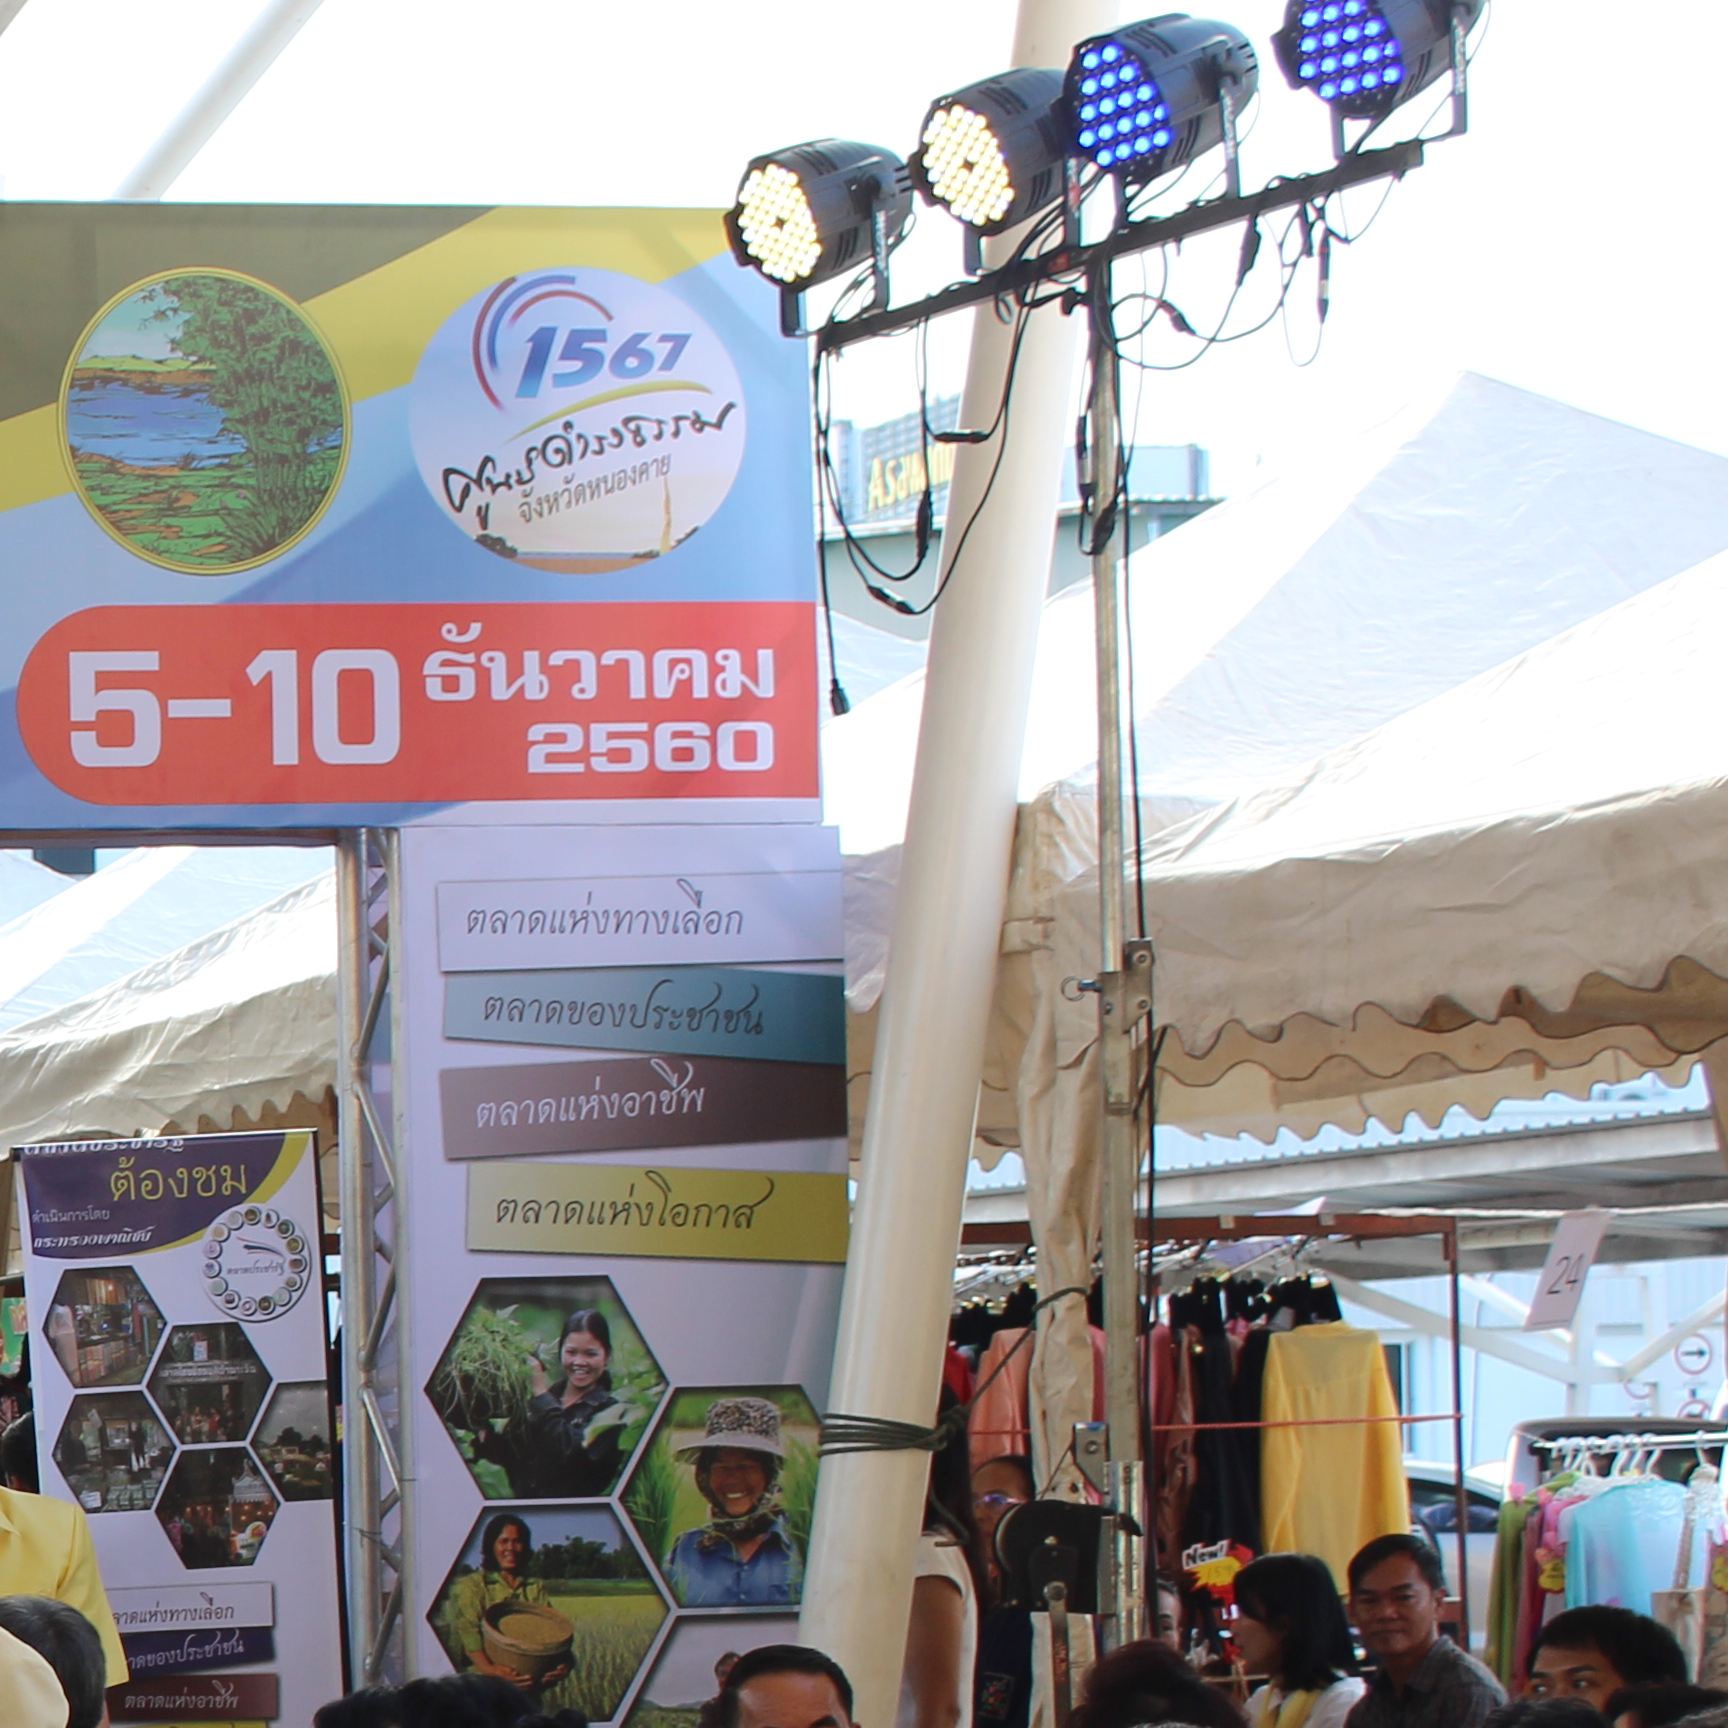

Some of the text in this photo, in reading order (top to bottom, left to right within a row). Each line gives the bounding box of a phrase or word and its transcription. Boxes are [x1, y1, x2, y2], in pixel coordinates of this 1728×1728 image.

[516, 324, 692, 399] 1567
[516, 452, 671, 528] จังหวัดหนองคาย
[424, 622, 775, 701] ธันวาคม
[67, 649, 403, 768] 5-10
[525, 721, 775, 774] 2560
[466, 878, 744, 936] ตลาดแห่งทางเลือก
[483, 978, 764, 1037] ตลาดของประชาชน
[476, 1058, 705, 1128] ตลาดแห่งอาชีพ
[110, 1157, 248, 1203] ต้องชม
[496, 1169, 774, 1230] ตลาดแห่งโอกาส
[32, 1205, 111, 1224] ดำเนินการโดย
[1546, 1252, 1584, 1294] 24
[113, 1592, 234, 1624] ลาดแห่งทางเลือก
[128, 1628, 244, 1670] าดของประชาชน
[125, 1680, 239, 1709] ตลาดแห่งอาชีพ
